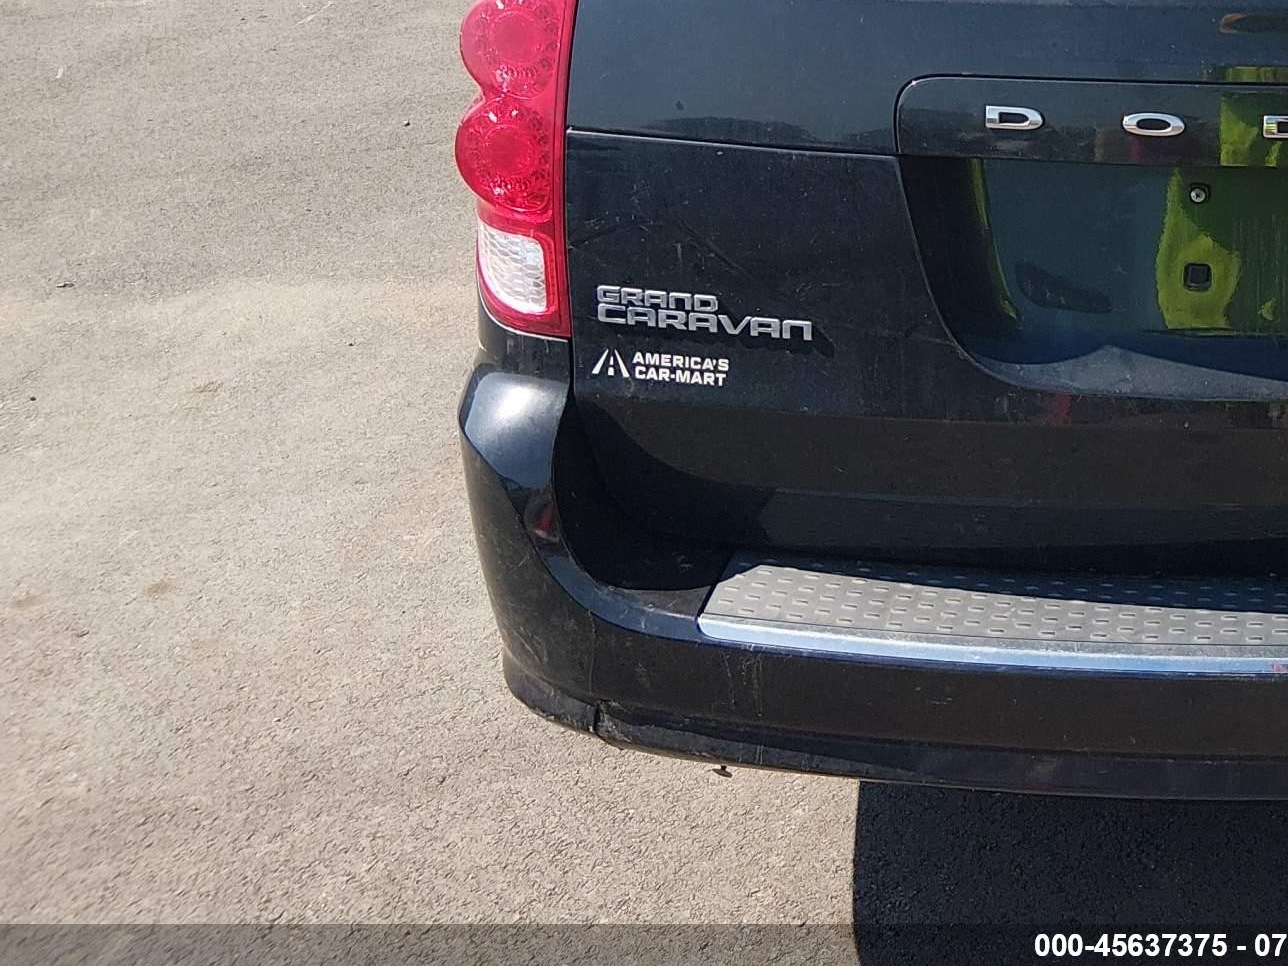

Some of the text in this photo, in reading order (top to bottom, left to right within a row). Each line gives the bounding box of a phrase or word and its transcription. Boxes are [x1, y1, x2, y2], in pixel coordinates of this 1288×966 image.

[597, 285, 718, 312] GRAND
[598, 303, 813, 341] CARAVAN
[632, 351, 730, 372] AMERICA'S
[634, 366, 727, 386] CAR-MART
